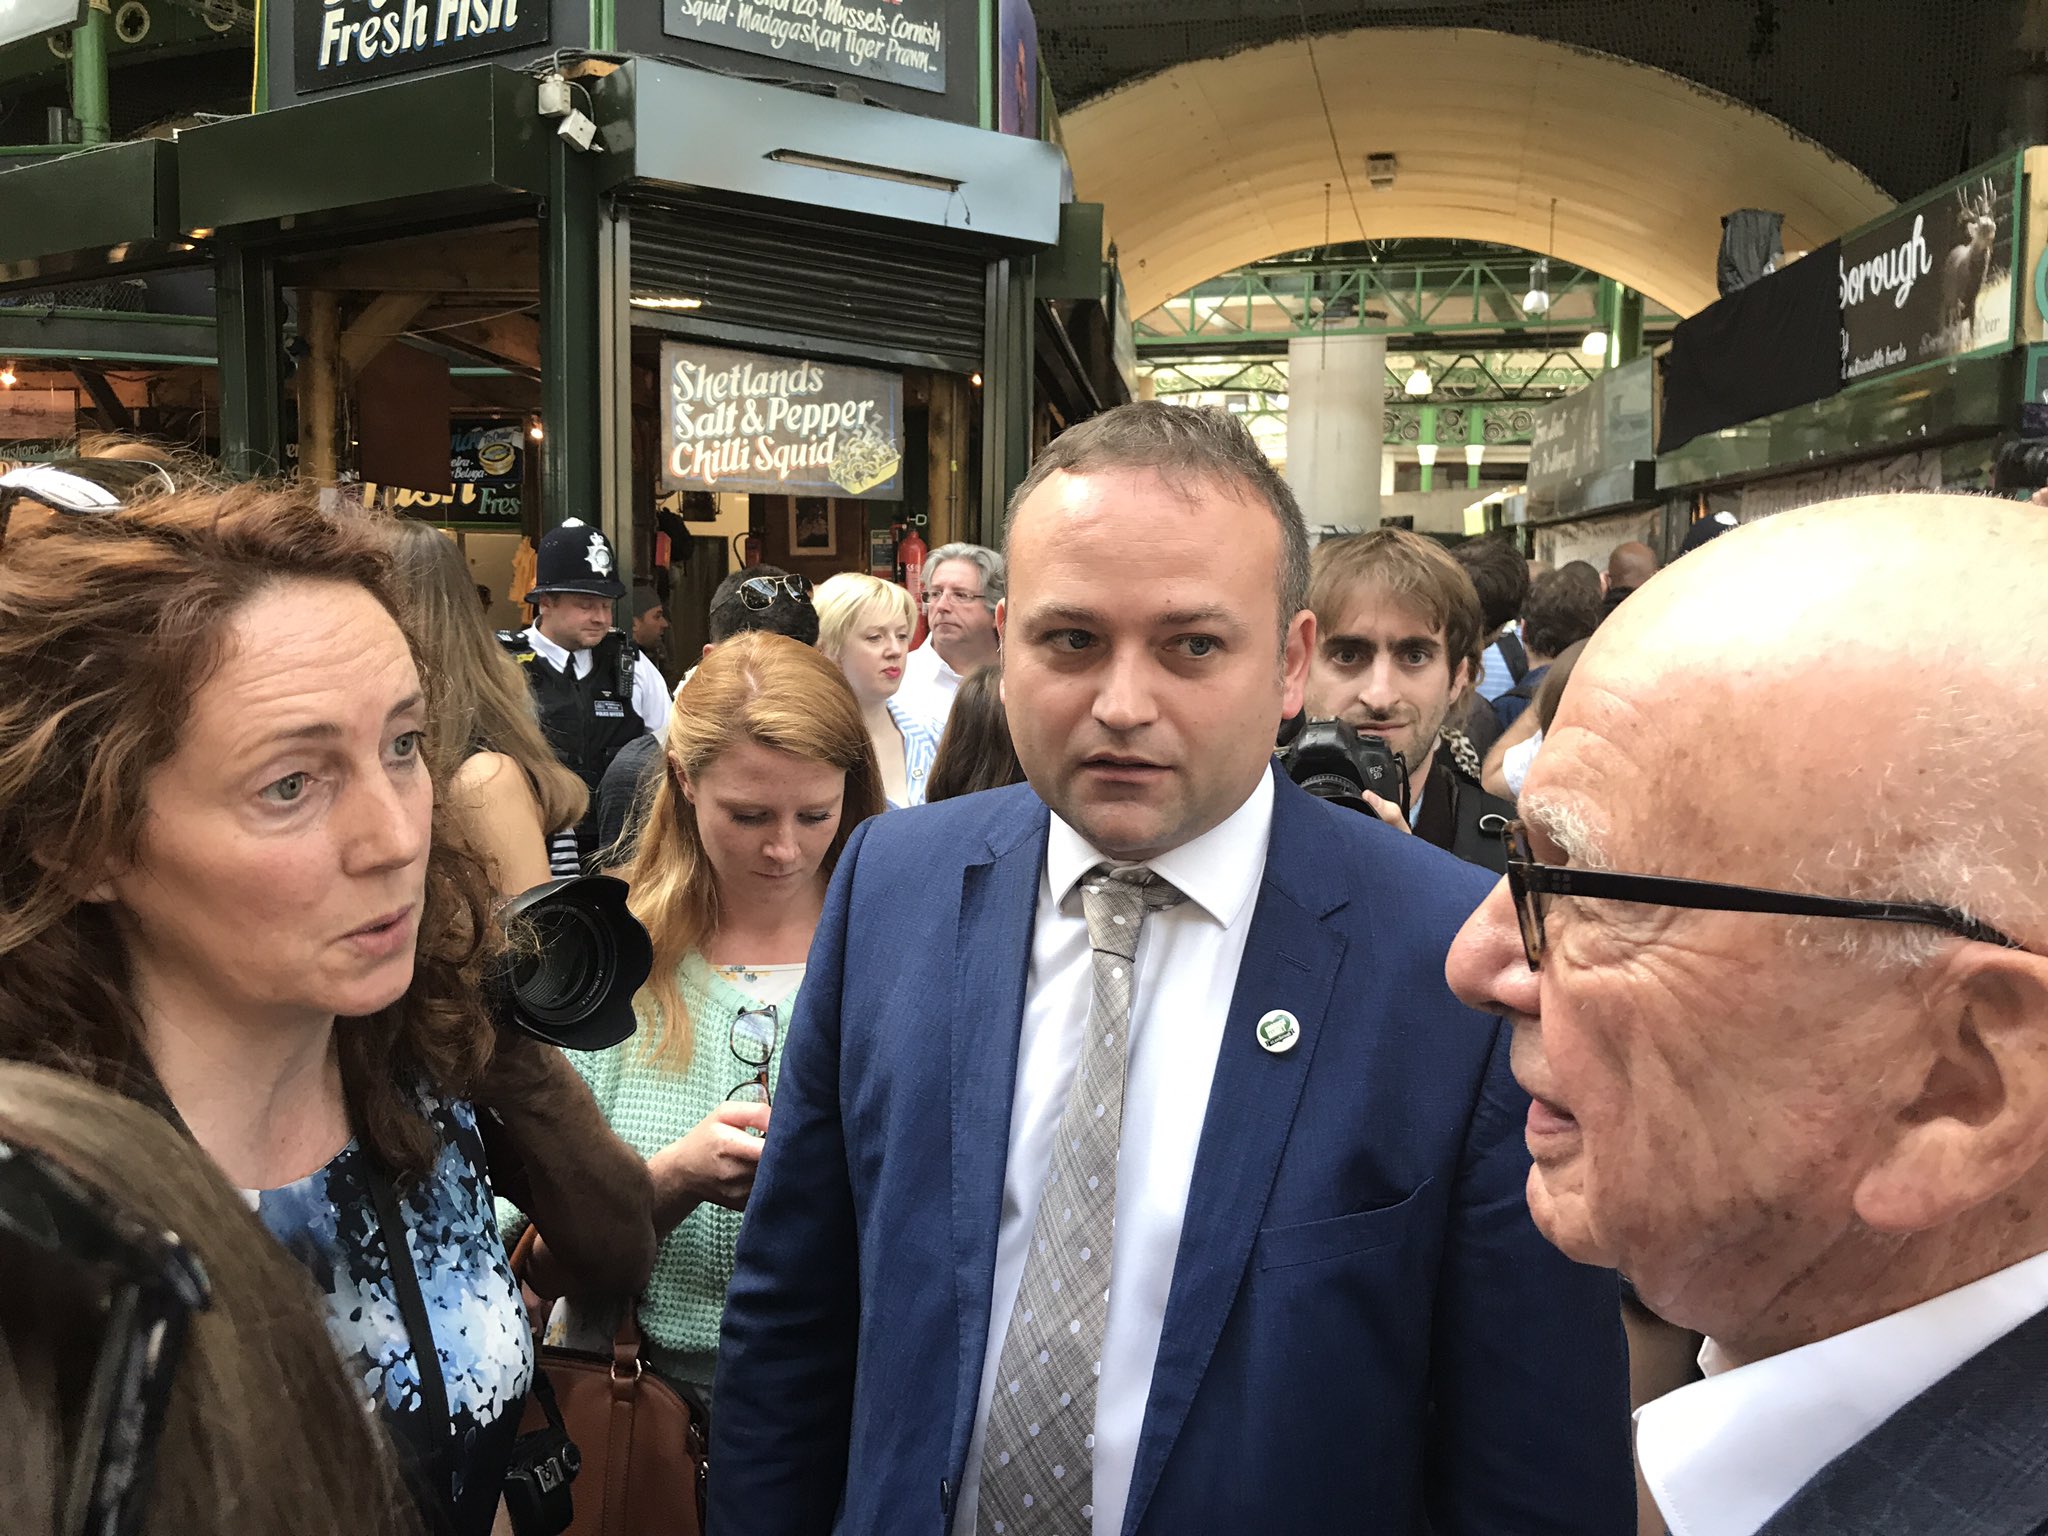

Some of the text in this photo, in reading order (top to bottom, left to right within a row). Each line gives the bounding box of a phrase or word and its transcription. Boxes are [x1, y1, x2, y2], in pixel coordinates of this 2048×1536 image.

[318, 0, 428, 69] Fresh
[681, 0, 730, 26] Squid
[736, 3, 842, 53] Madagaskan
[843, 27, 885, 66] Tiger
[822, 0, 887, 35] Mussels
[890, 13, 941, 52] Cornish
[673, 359, 825, 406] Shetlands
[675, 397, 874, 439] Salt & Pepper
[454, 466, 485, 482] Beluga
[671, 431, 838, 484] Chilli Squid
[478, 487, 522, 515] Fres
[1370, 765, 1383, 774] EOS
